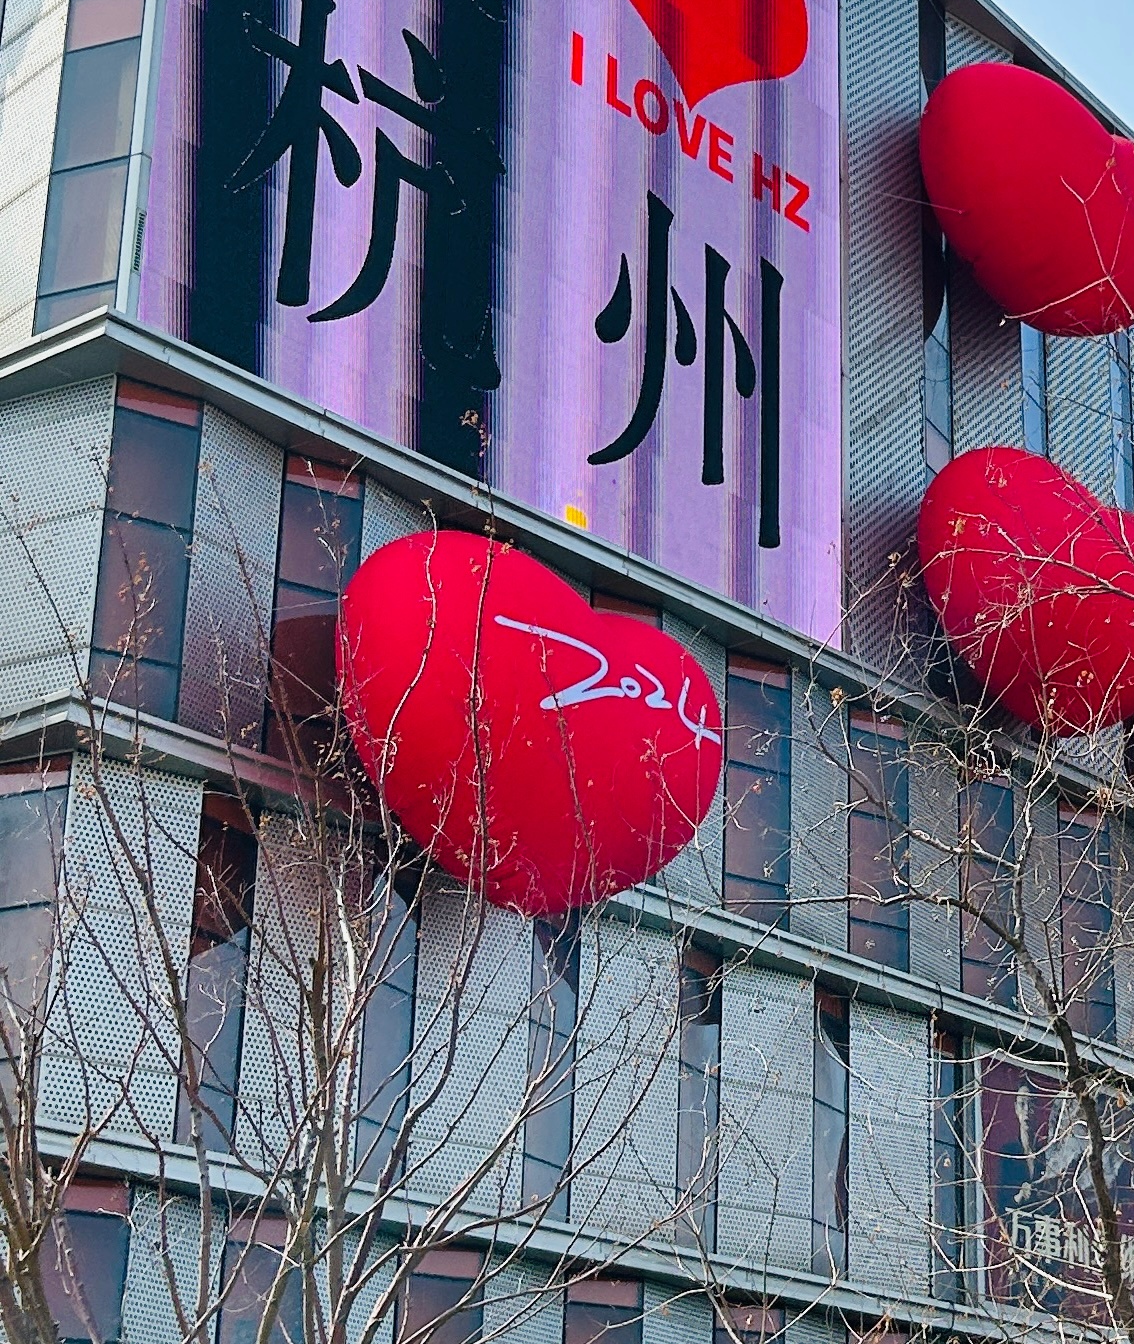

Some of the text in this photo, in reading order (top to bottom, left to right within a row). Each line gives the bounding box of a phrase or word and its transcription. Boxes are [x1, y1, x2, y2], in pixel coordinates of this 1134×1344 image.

[570, 30, 810, 234] I LOVE HZ
[494, 614, 722, 751] 2024
